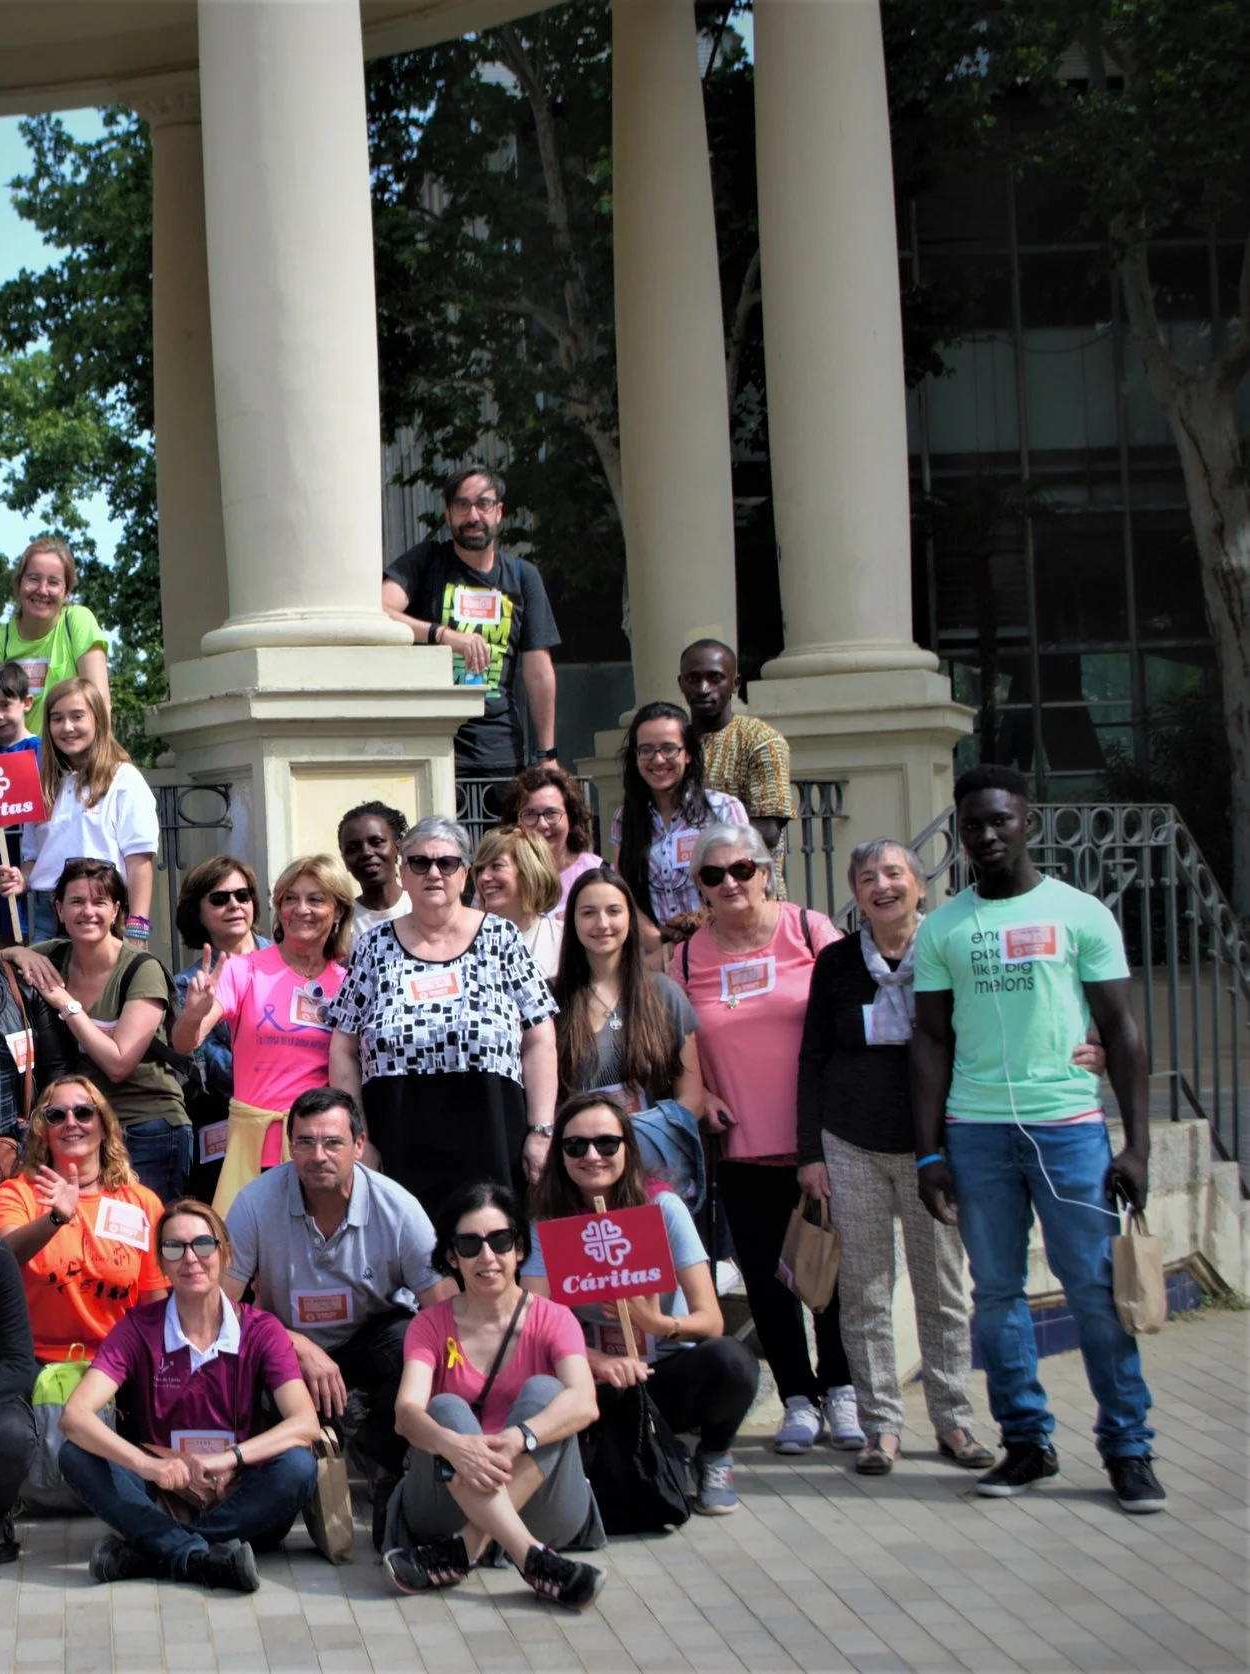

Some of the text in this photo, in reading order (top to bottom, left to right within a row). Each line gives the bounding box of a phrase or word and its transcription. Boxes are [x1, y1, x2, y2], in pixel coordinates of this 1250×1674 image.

[971, 930, 999, 944] en
[972, 963, 999, 976] like
[974, 976, 1034, 994] melons
[562, 1267, 661, 1294] Cáritas
